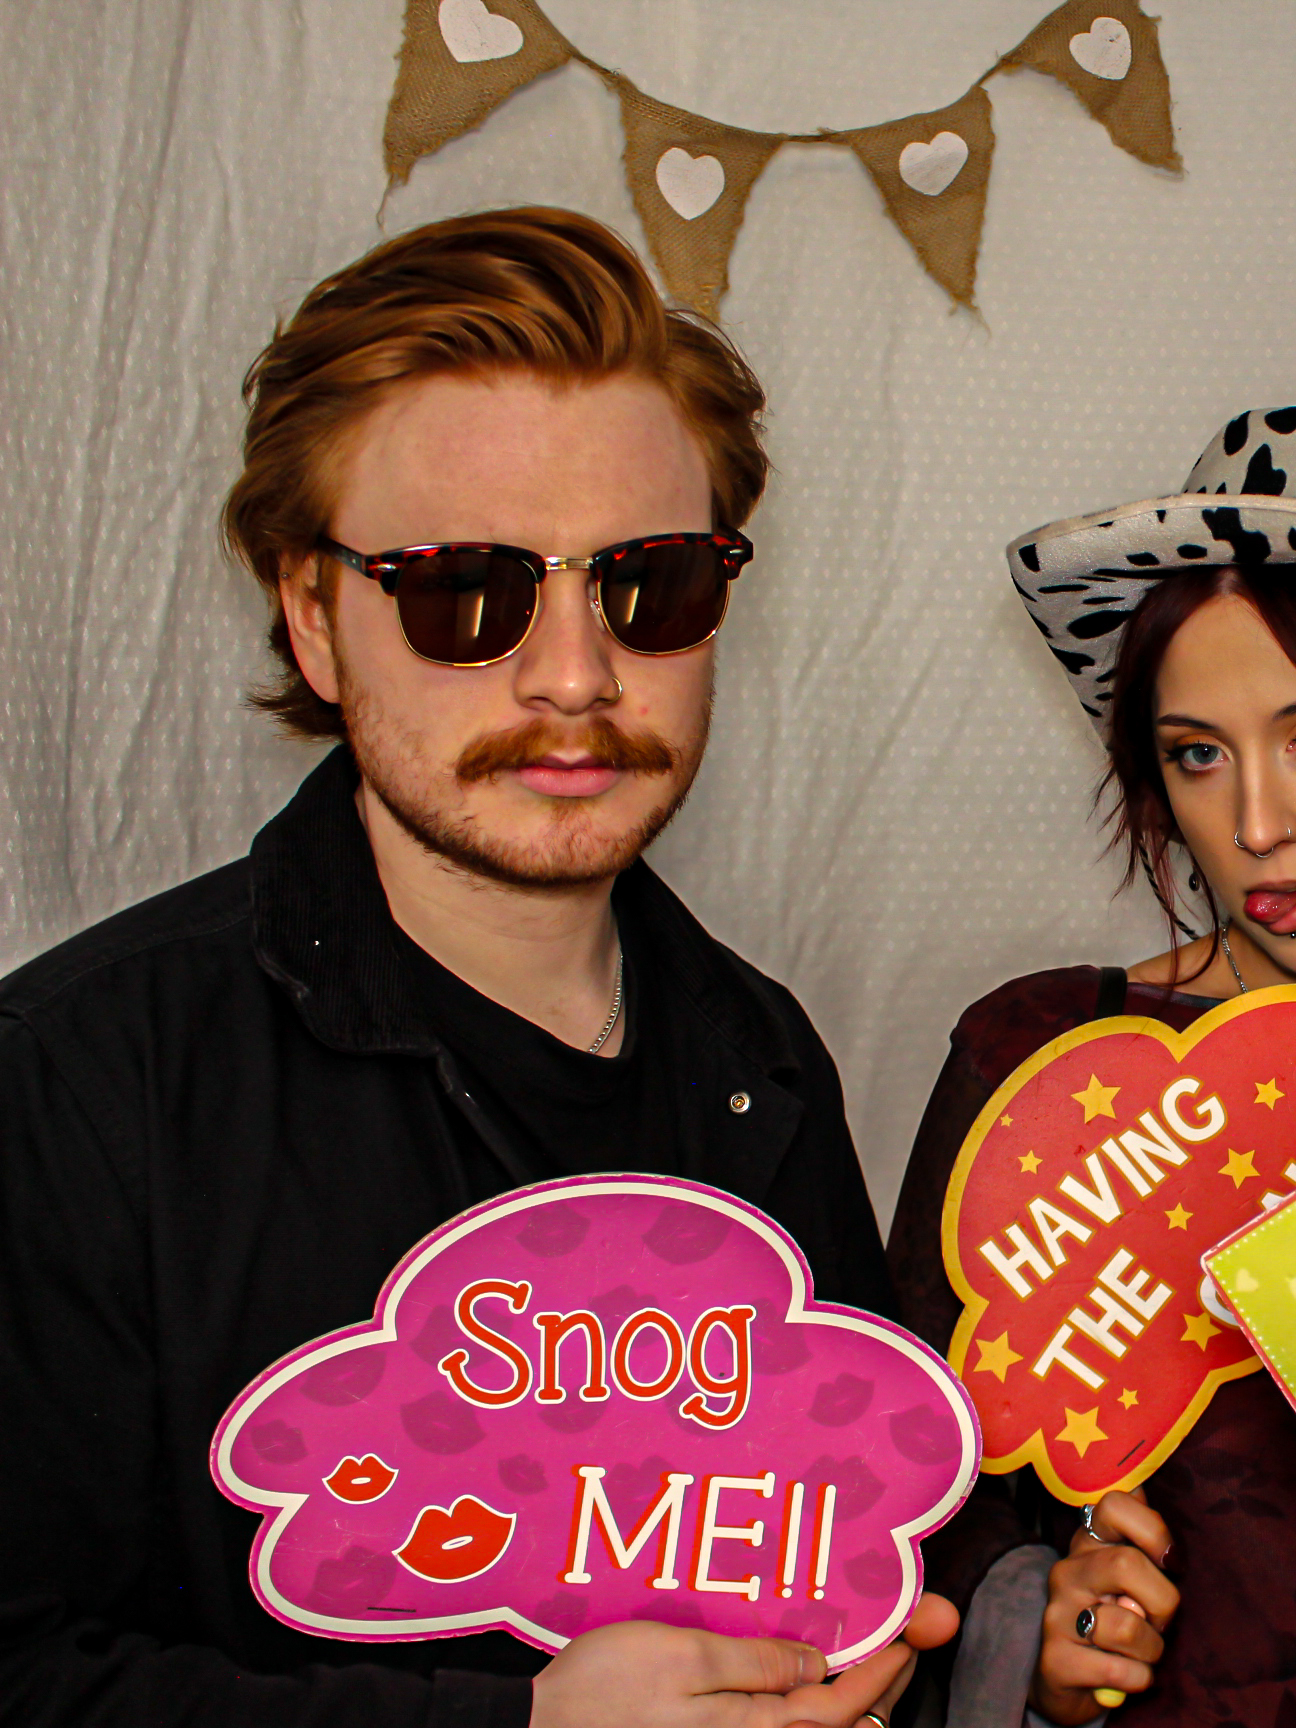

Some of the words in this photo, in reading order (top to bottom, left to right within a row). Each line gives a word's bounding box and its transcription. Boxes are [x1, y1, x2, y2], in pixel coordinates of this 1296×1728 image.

[977, 1076, 1227, 1300] HAVING
[438, 1278, 756, 1431] Snog
[1029, 1246, 1175, 1391] THE
[556, 1464, 837, 1602] ME!!
